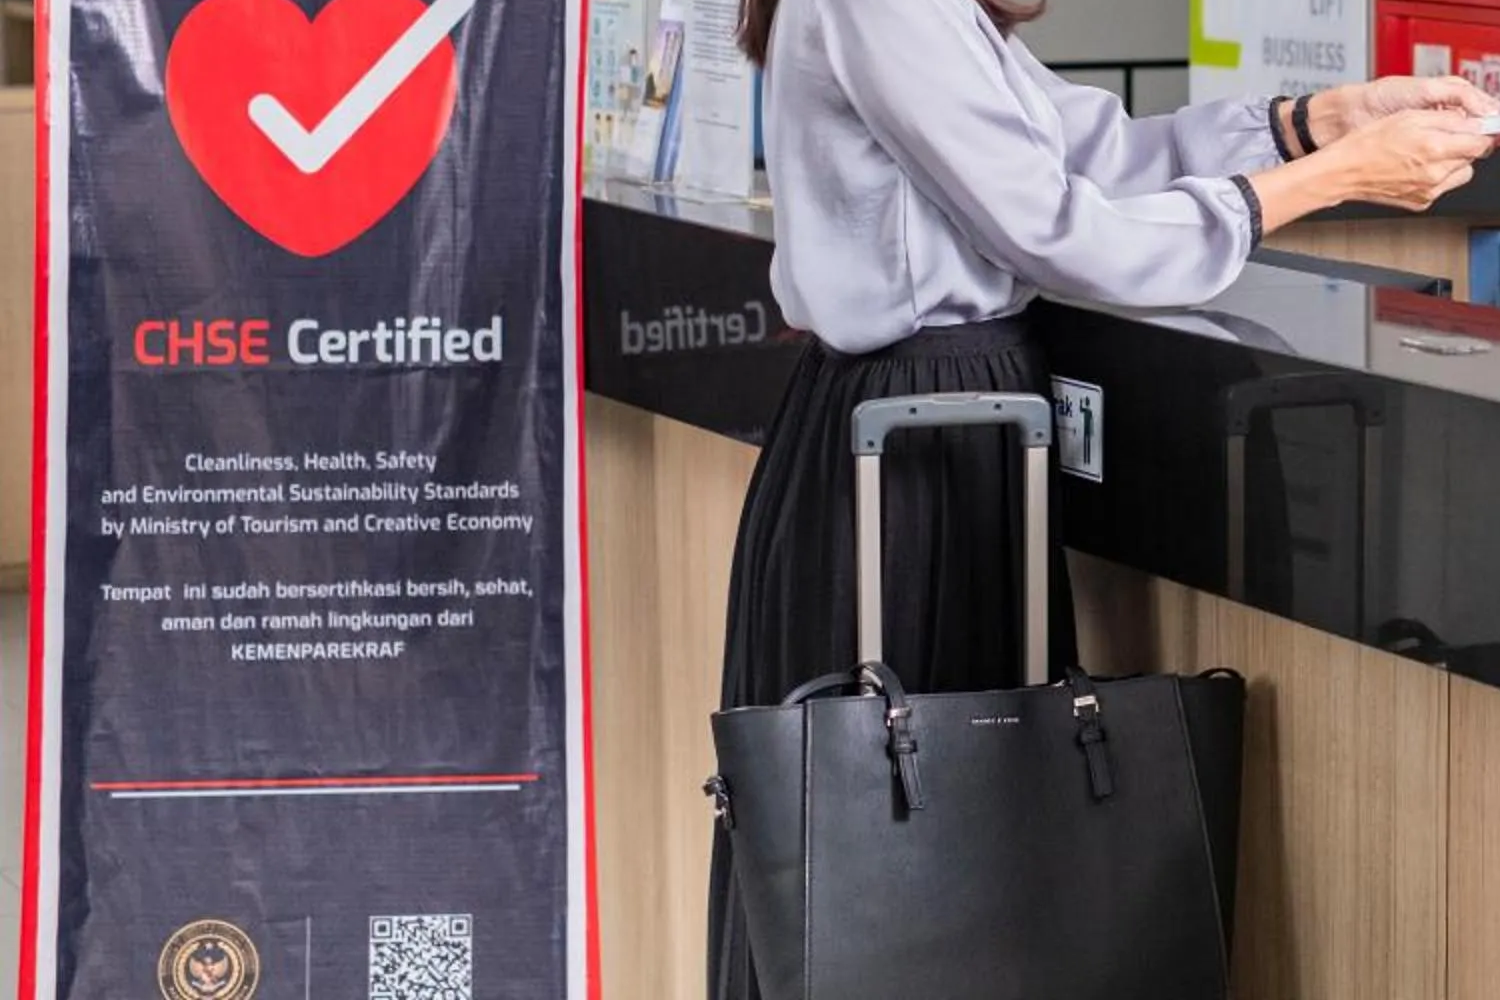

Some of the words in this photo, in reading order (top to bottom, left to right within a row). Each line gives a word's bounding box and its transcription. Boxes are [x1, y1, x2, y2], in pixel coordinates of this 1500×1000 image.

[1262, 36, 1346, 72] BUSINESS
[134, 320, 270, 365] CHSE
[287, 316, 502, 363] Certified
[186, 454, 298, 471] Cleanliness,
[376, 451, 436, 472] Safety
[102, 486, 136, 503] and
[143, 485, 283, 502] Environmental
[290, 483, 418, 503] Sustainability
[424, 481, 519, 499] Standards
[102, 518, 124, 538] by
[131, 517, 210, 537] Ministry
[216, 516, 234, 533] of
[241, 516, 318, 532] Tourism
[324, 515, 358, 532] and
[365, 514, 440, 532] Creative
[448, 514, 533, 532] Economy
[102, 585, 171, 602] Tempat
[184, 585, 205, 598] ini
[213, 583, 269, 598] sudah
[276, 581, 400, 598] bersertifikasi
[407, 579, 470, 598] bersih,
[476, 579, 532, 596] sehat,
[162, 618, 214, 630] aman
[221, 614, 255, 629] dan
[262, 613, 321, 628] ramah
[329, 611, 431, 631] lingkungan
[438, 610, 473, 625] dari
[232, 642, 403, 660] KEMENPAREKRAF
